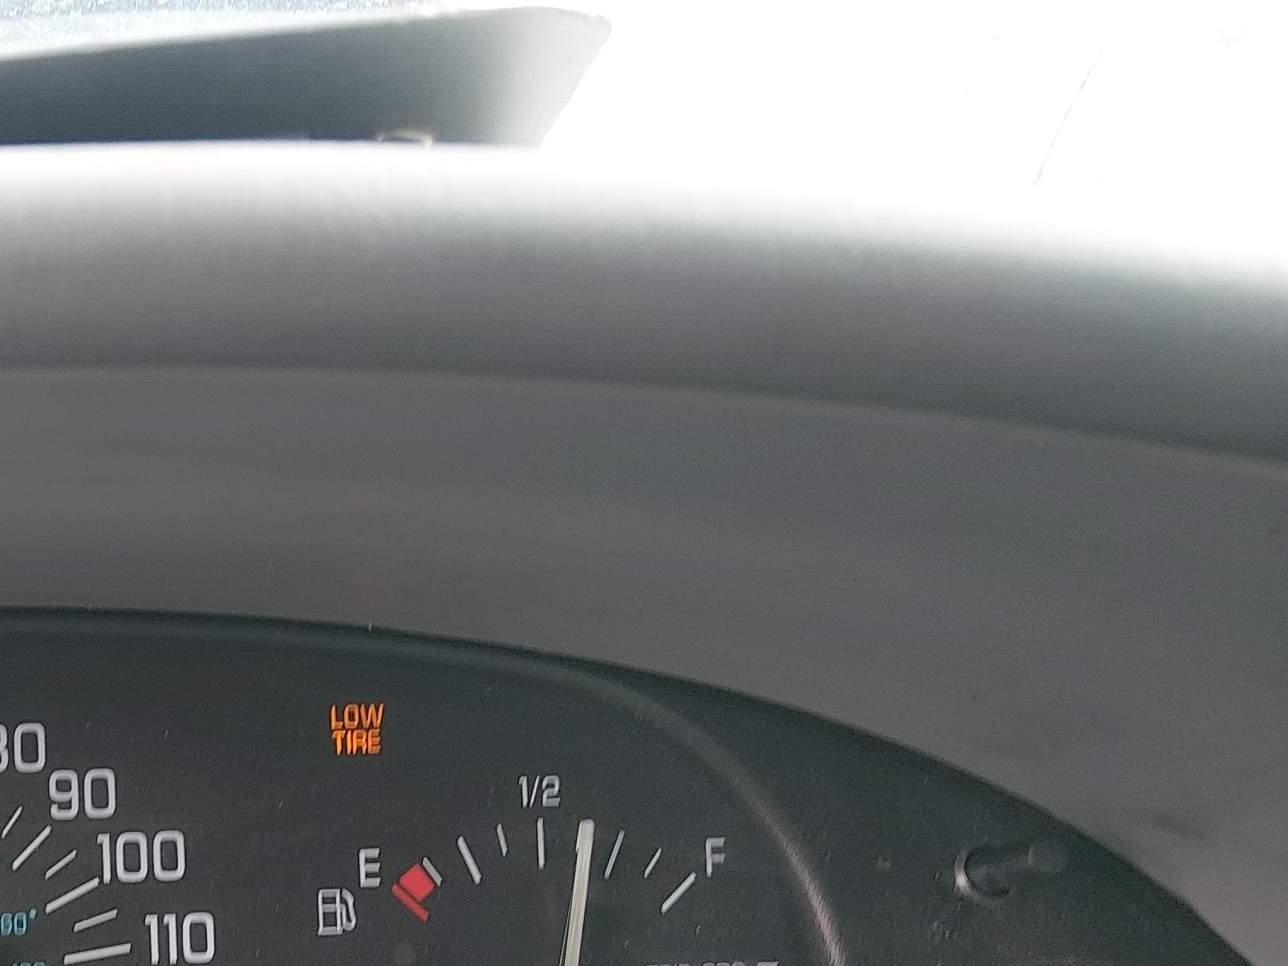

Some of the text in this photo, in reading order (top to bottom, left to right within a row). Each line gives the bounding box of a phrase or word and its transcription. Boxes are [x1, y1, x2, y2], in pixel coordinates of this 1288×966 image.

[330, 703, 385, 730] LOW
[331, 729, 382, 756] TIRE
[48, 767, 116, 821] 90
[518, 774, 561, 808] 1/2
[96, 829, 186, 885] 100
[358, 847, 381, 888] E
[704, 837, 726, 878] F
[144, 911, 215, 966] 110
